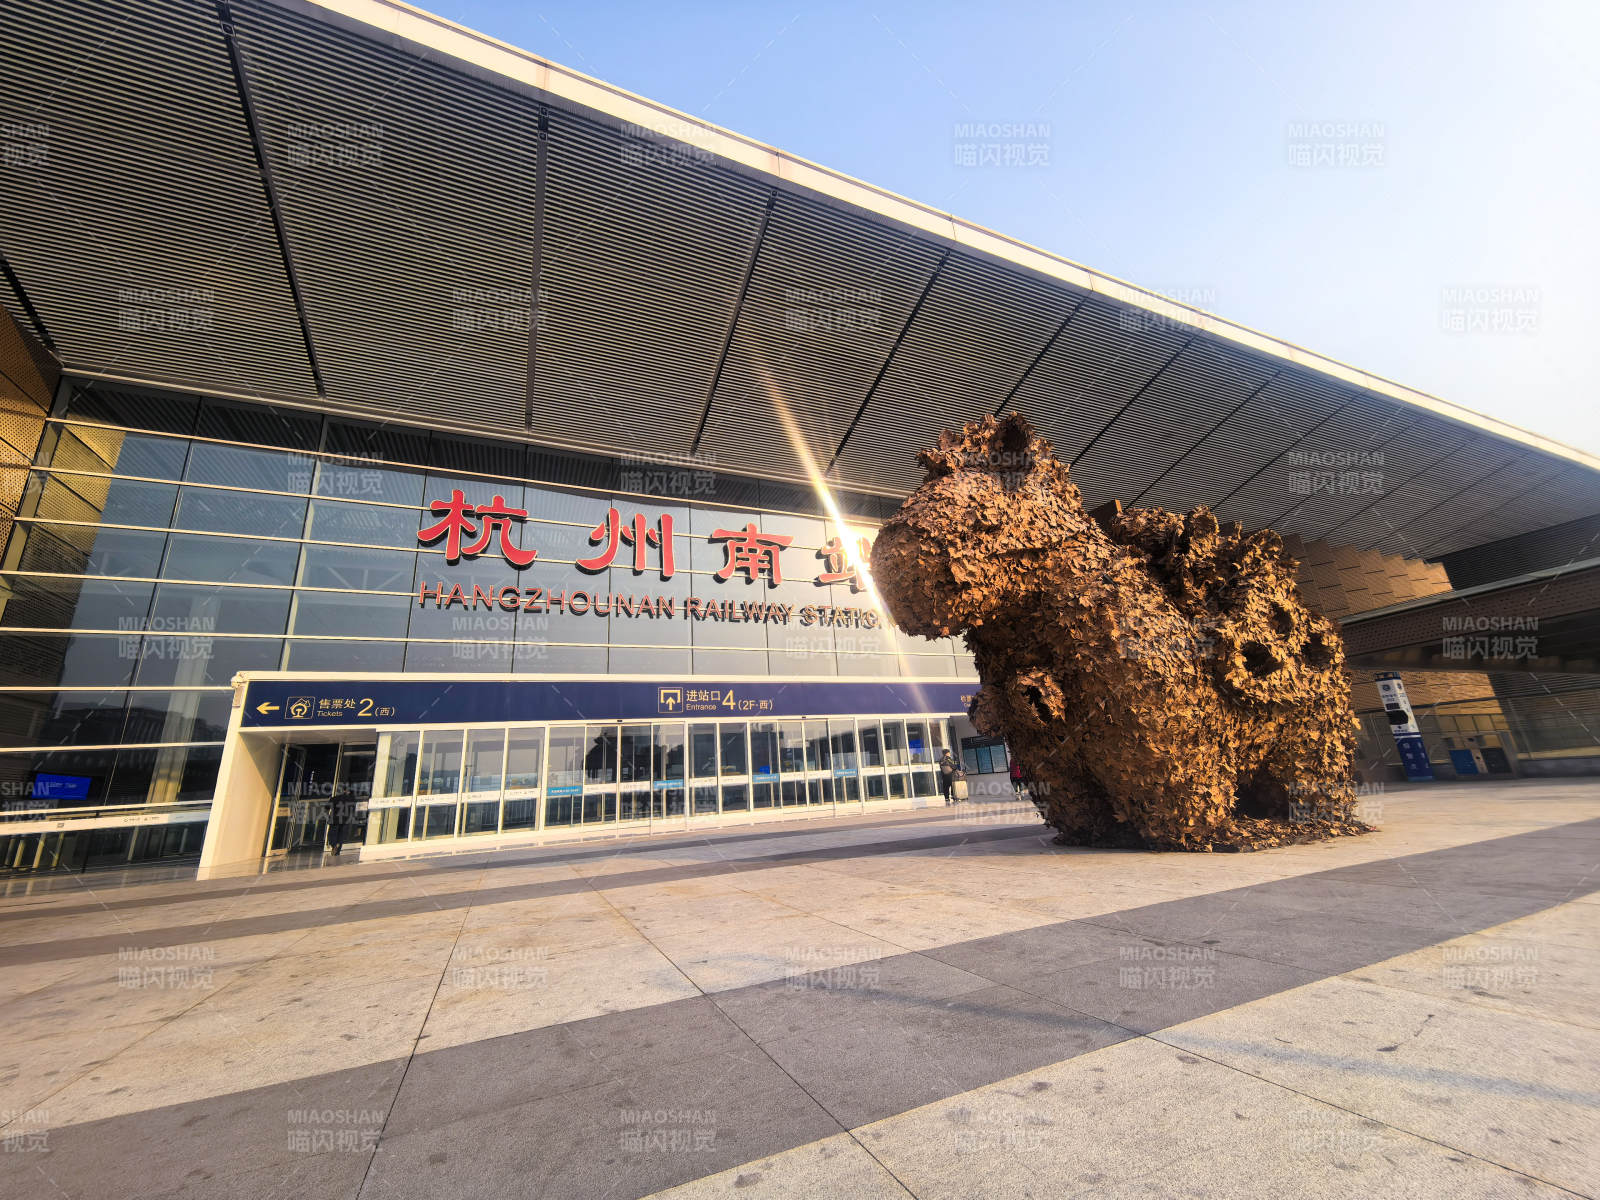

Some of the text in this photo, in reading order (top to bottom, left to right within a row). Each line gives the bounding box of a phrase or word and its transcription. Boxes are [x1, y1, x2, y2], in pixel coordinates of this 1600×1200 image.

[419, 582, 678, 616] HANGZHOUNAN
[687, 597, 795, 621] RAILWAY
[802, 604, 885, 628] STATIO
[319, 698, 356, 710] 售票处
[357, 698, 374, 717] 2
[686, 690, 721, 702] 进站口
[722, 689, 737, 711] 4
[686, 703, 717, 711] Entrance
